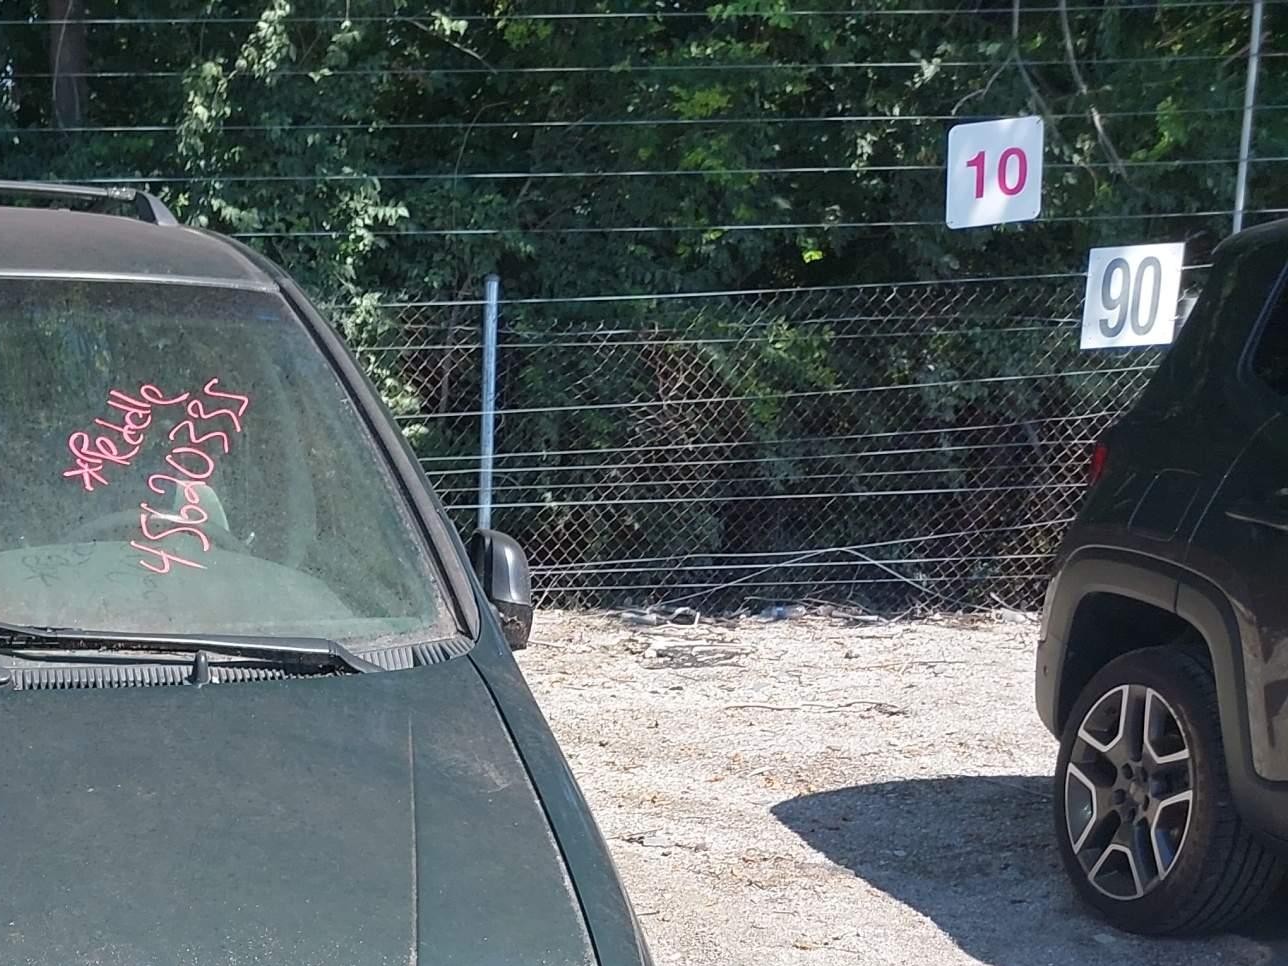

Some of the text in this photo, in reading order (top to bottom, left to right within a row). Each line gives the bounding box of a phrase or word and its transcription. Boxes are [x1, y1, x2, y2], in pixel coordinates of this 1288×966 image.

[965, 146, 1029, 200] 10
[1098, 255, 1163, 338] 90
[129, 378, 249, 574] 45620335
